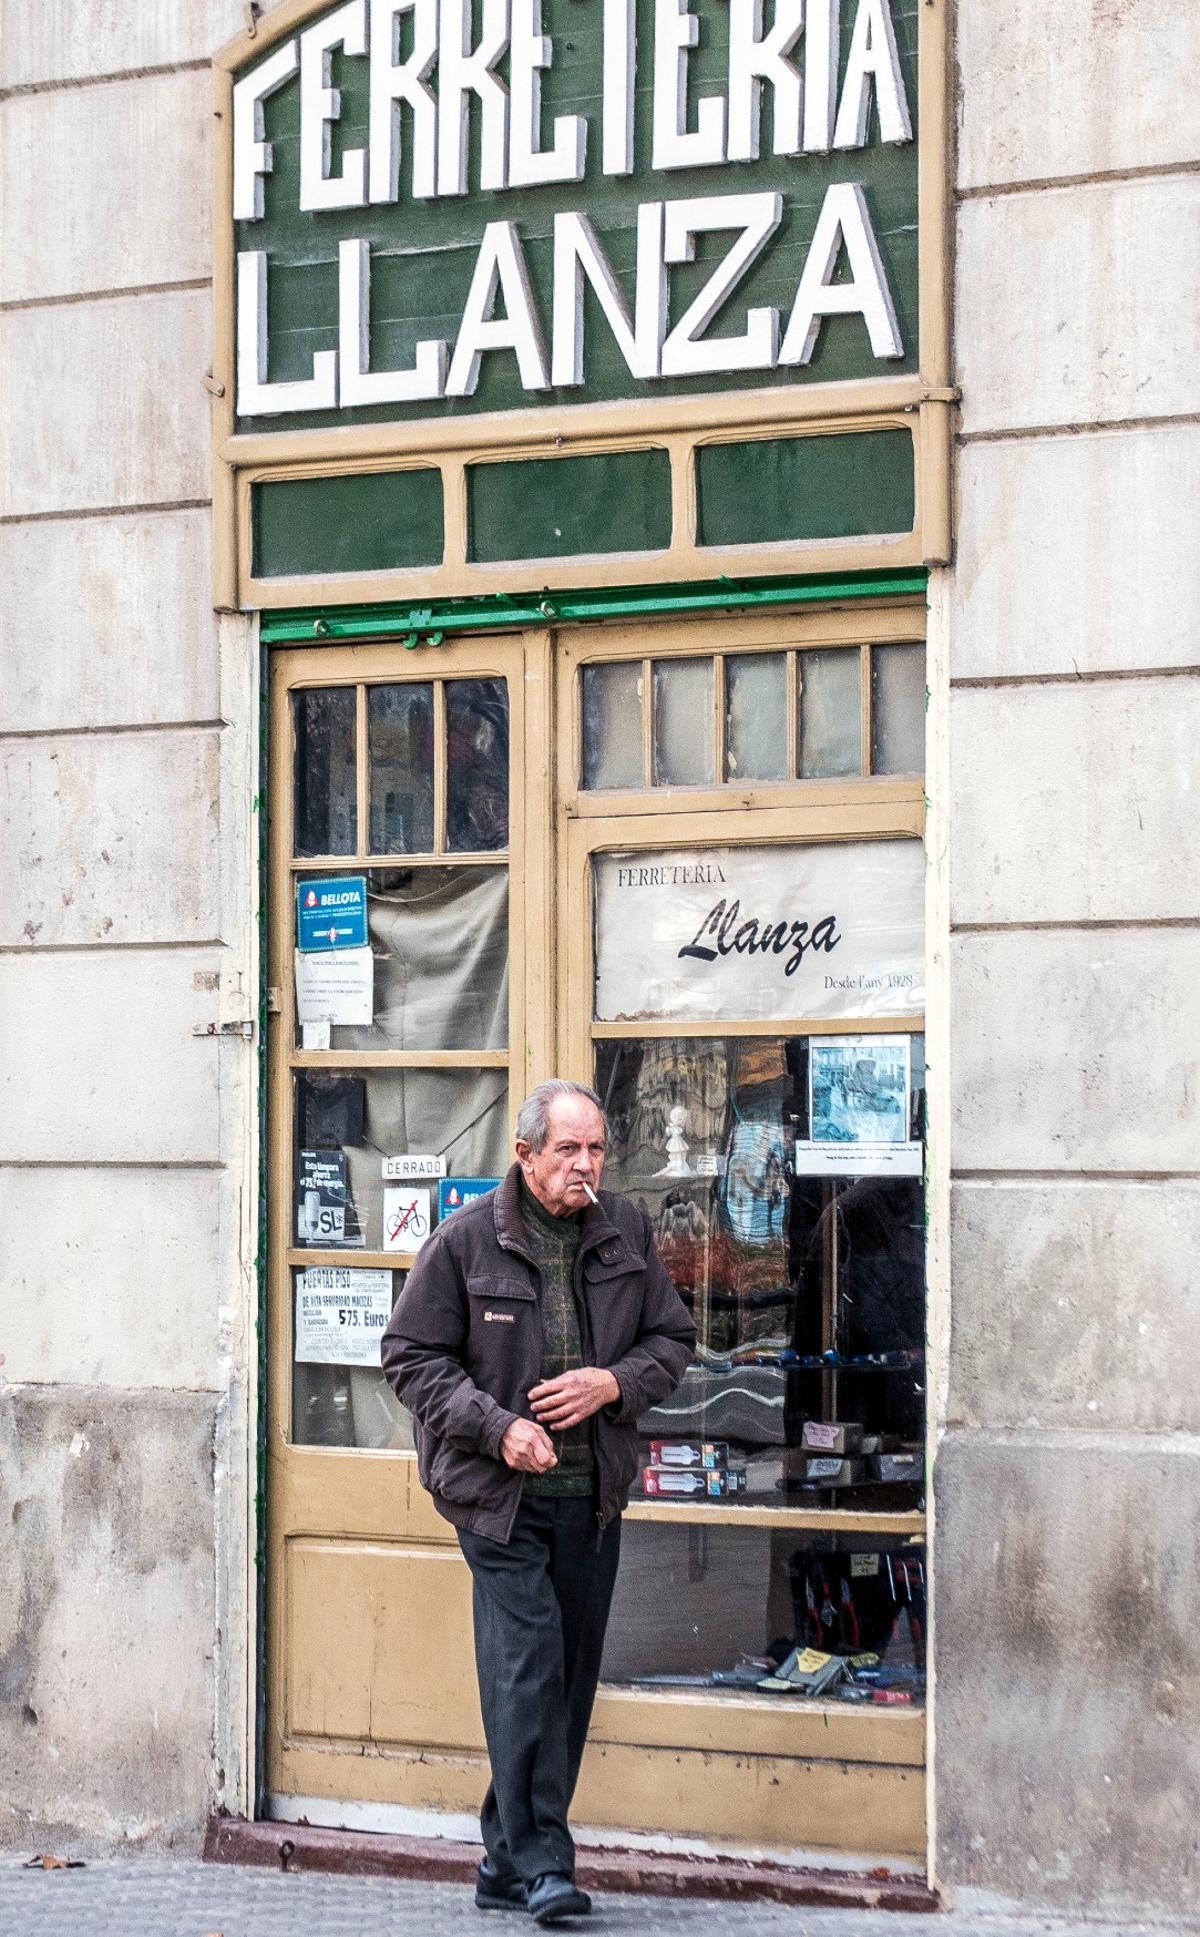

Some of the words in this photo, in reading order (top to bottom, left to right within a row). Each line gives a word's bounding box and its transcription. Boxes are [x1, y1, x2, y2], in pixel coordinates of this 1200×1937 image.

[237, 183, 904, 416] LLANZA
[618, 864, 727, 887] FERRETERIA
[321, 891, 360, 906] BELLOTA
[678, 898, 842, 977] Llanza
[824, 975, 855, 989] Desde
[888, 974, 913, 988] 1928
[387, 1161, 441, 1174] CERRADO
[364, 1310, 389, 1327] Euros
